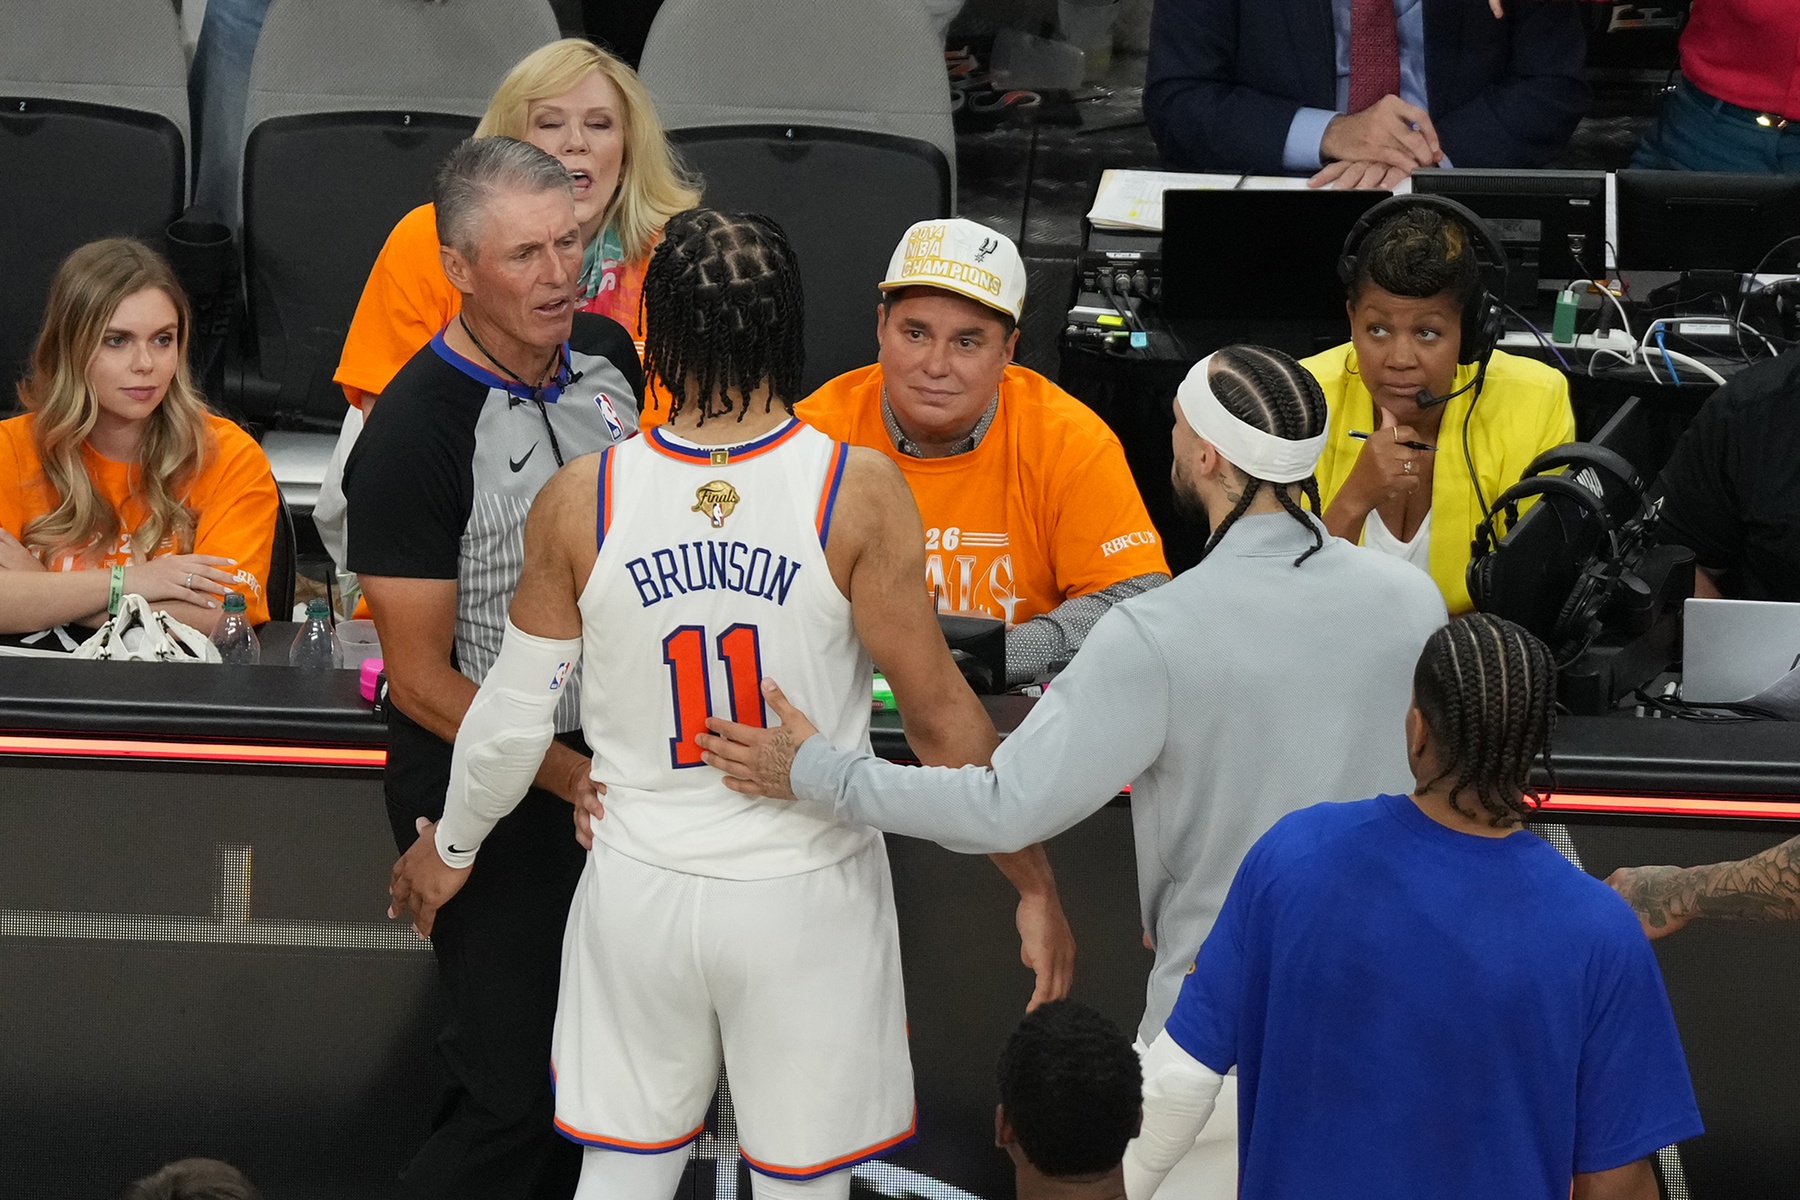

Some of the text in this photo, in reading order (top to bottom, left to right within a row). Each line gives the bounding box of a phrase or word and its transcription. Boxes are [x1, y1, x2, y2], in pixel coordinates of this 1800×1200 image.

[19, 101, 26, 111] 2
[404, 114, 410, 124] 3
[785, 128, 792, 138] 4
[908, 225, 946, 242] 2014
[904, 239, 941, 260] NBA
[902, 257, 1002, 296] CHAMPIONS
[691, 486, 738, 510] Finals
[1100, 530, 1150, 557] RBFCU
[625, 540, 801, 608] BRUNSON
[661, 622, 768, 770] 11
